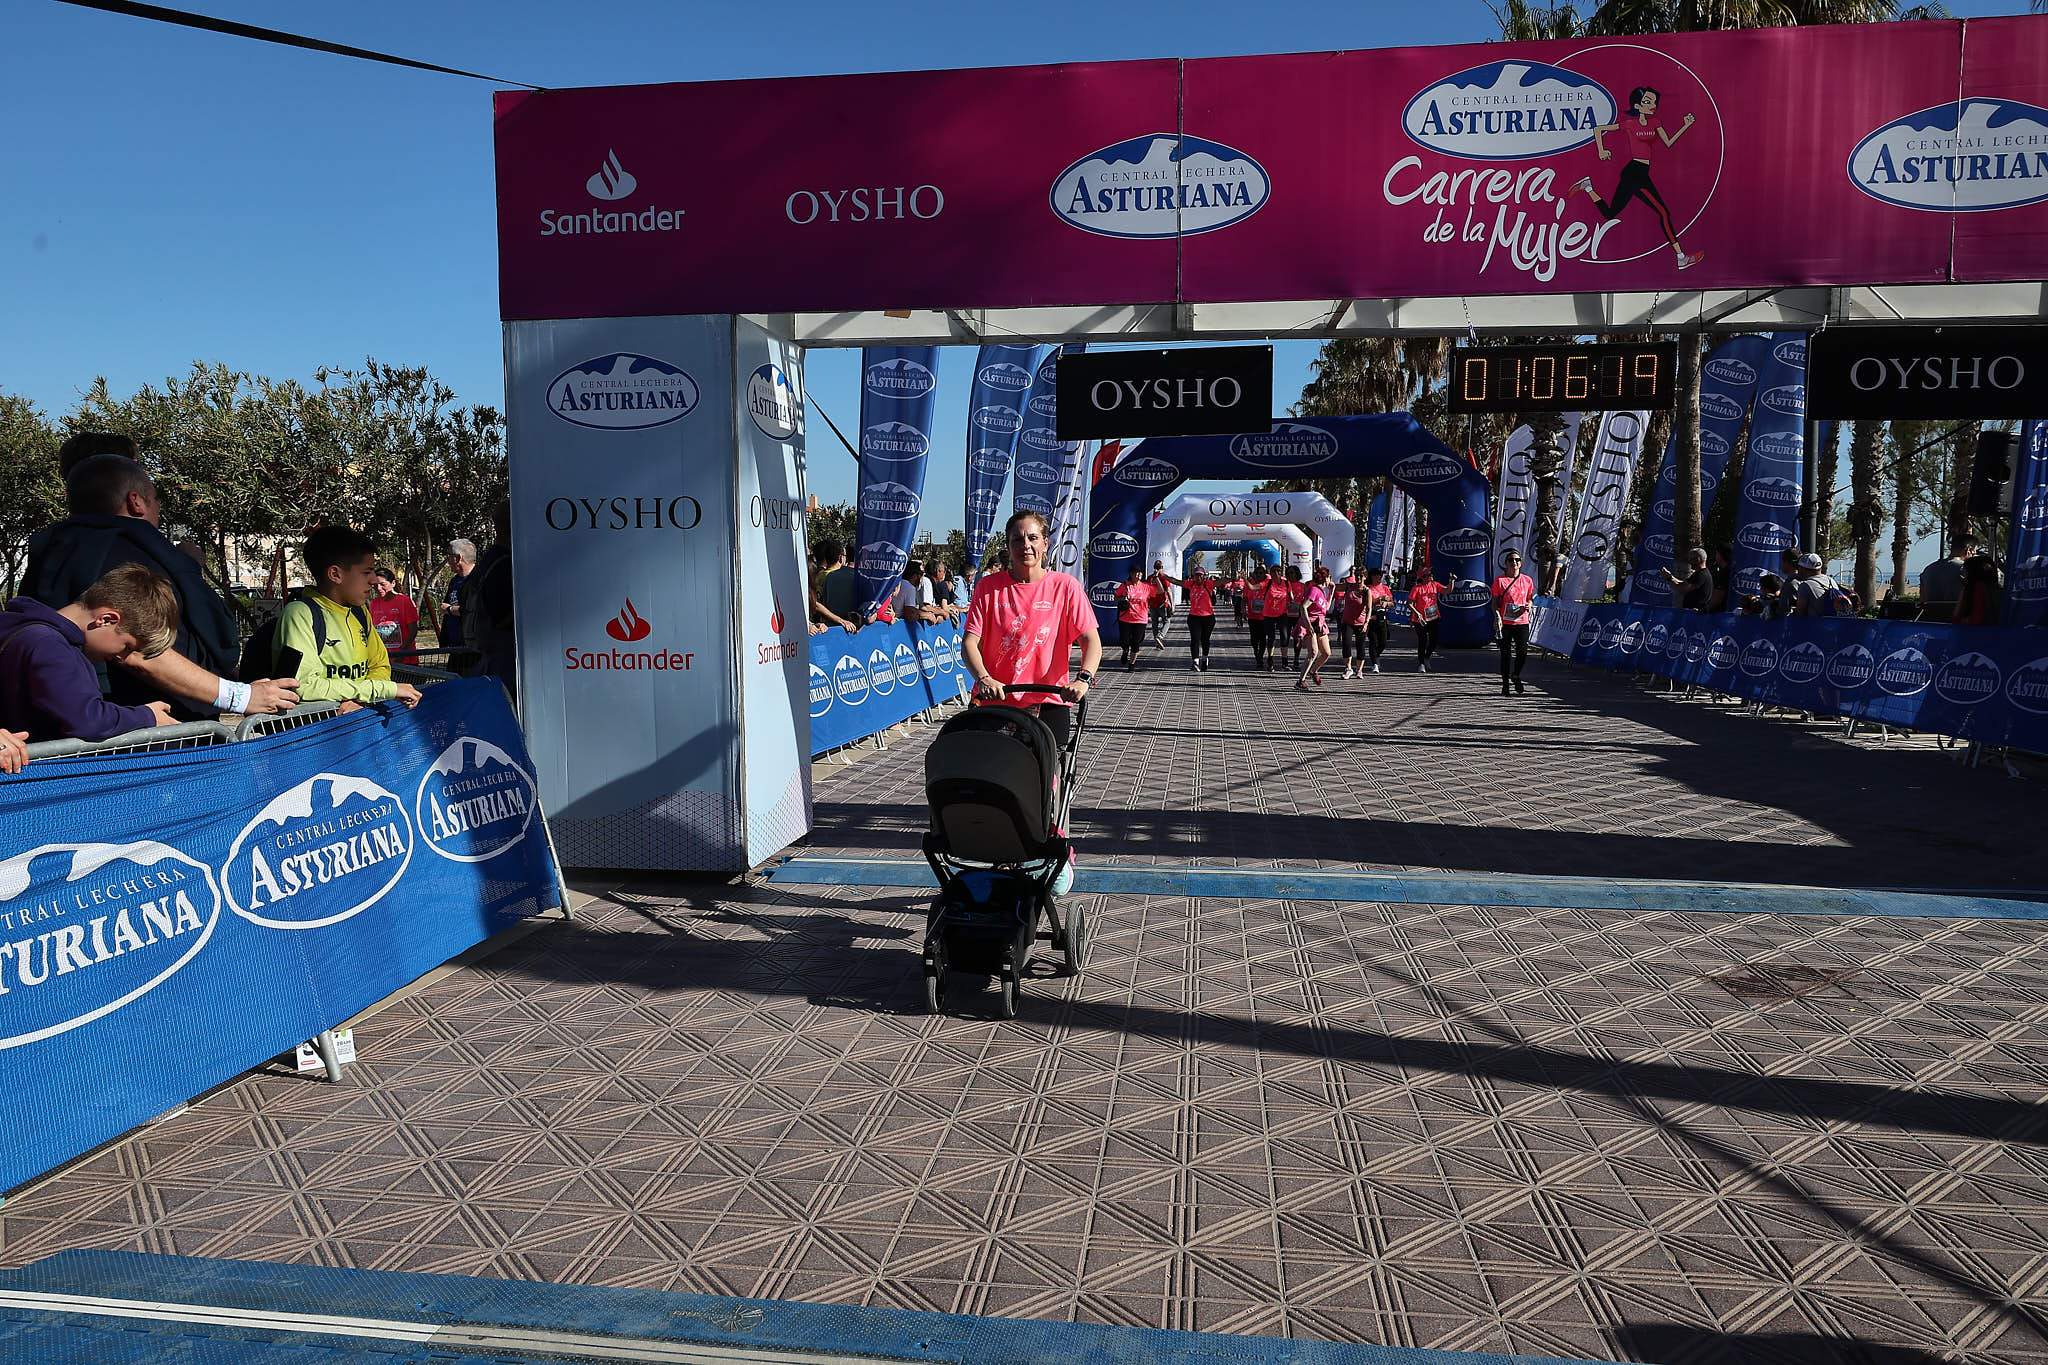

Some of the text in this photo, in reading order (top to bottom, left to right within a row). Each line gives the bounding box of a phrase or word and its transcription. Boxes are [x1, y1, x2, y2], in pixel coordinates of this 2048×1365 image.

[1452, 92, 1593, 106] CENTRAL LECHERA
[1419, 98, 1598, 136] ASTURIANA
[1906, 136, 1984, 151] CENTRAL
[1100, 169, 1168, 182] CENTRAL
[1383, 156, 1555, 207] Carrera
[785, 184, 945, 225] OYSHO
[1067, 176, 1253, 214] ASTURIANA
[540, 205, 685, 235] Santander
[1423, 203, 1621, 282] de la Mujer
[581, 378, 683, 388] CENTRAL LECHERA
[867, 371, 928, 390] ASTURIANA
[1465, 355, 1657, 400] 01:06:19
[1708, 363, 1752, 381] ASTURIANA
[1850, 356, 2024, 391] OYSHO
[558, 383, 689, 412] ASTURIANA
[1091, 377, 1241, 411] OYSHO
[863, 434, 922, 453] ASTURIANA
[1238, 438, 1330, 456] ASTURIANA
[1118, 469, 1174, 480] ASTURIANA
[1398, 465, 1458, 477] ASTURIANA
[1576, 411, 1641, 562] OYSHO
[545, 496, 702, 530] OYSHO
[751, 495, 800, 532] OYSHO
[1209, 499, 1291, 516] OYSHO
[1093, 542, 1135, 552] ASTURIANA
[565, 647, 694, 671] Santander
[758, 641, 798, 665] Santander
[1828, 660, 1870, 679] ASTURIANA
[1877, 662, 1927, 685] ASTURIANA
[1938, 669, 1994, 692] ASTURIANA
[442, 780, 480, 797] CENTRAL
[276, 802, 393, 849] CENTRAL LECHERA
[429, 786, 527, 843] ASTURIANA
[248, 822, 405, 910] ASTURIANA
[75, 867, 187, 909] LECHERA
